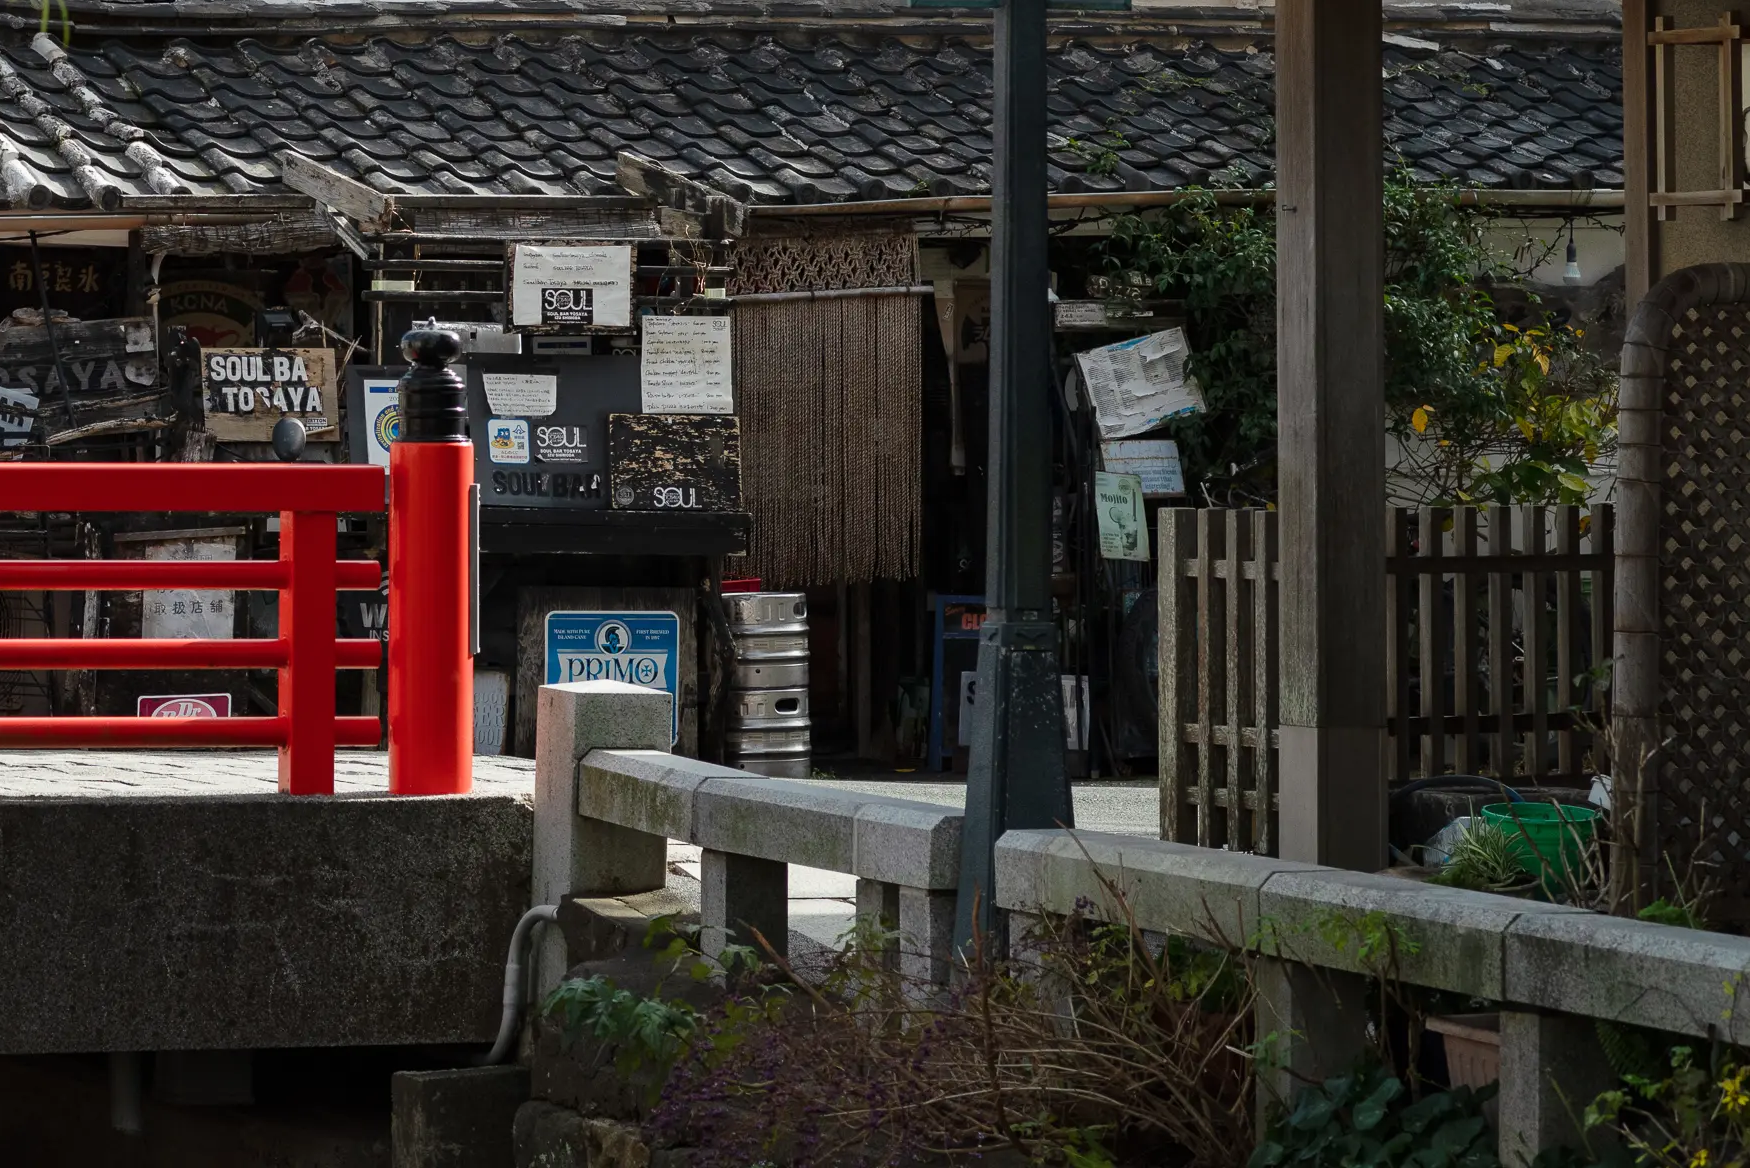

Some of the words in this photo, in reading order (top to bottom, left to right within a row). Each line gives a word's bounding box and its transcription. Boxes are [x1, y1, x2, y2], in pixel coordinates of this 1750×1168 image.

[544, 289, 593, 310] SOUL
[210, 356, 271, 382] SOUL
[537, 426, 587, 447] SOUL
[492, 470, 550, 497] SOUL
[653, 486, 703, 508] SOUL
[1100, 493, 1128, 505] Mojito
[154, 600, 223, 616] 取扱店舗
[566, 657, 659, 685] PRIMO
[178, 702, 201, 717] Dr
[474, 705, 507, 728] EER
[474, 727, 504, 748] OOD
